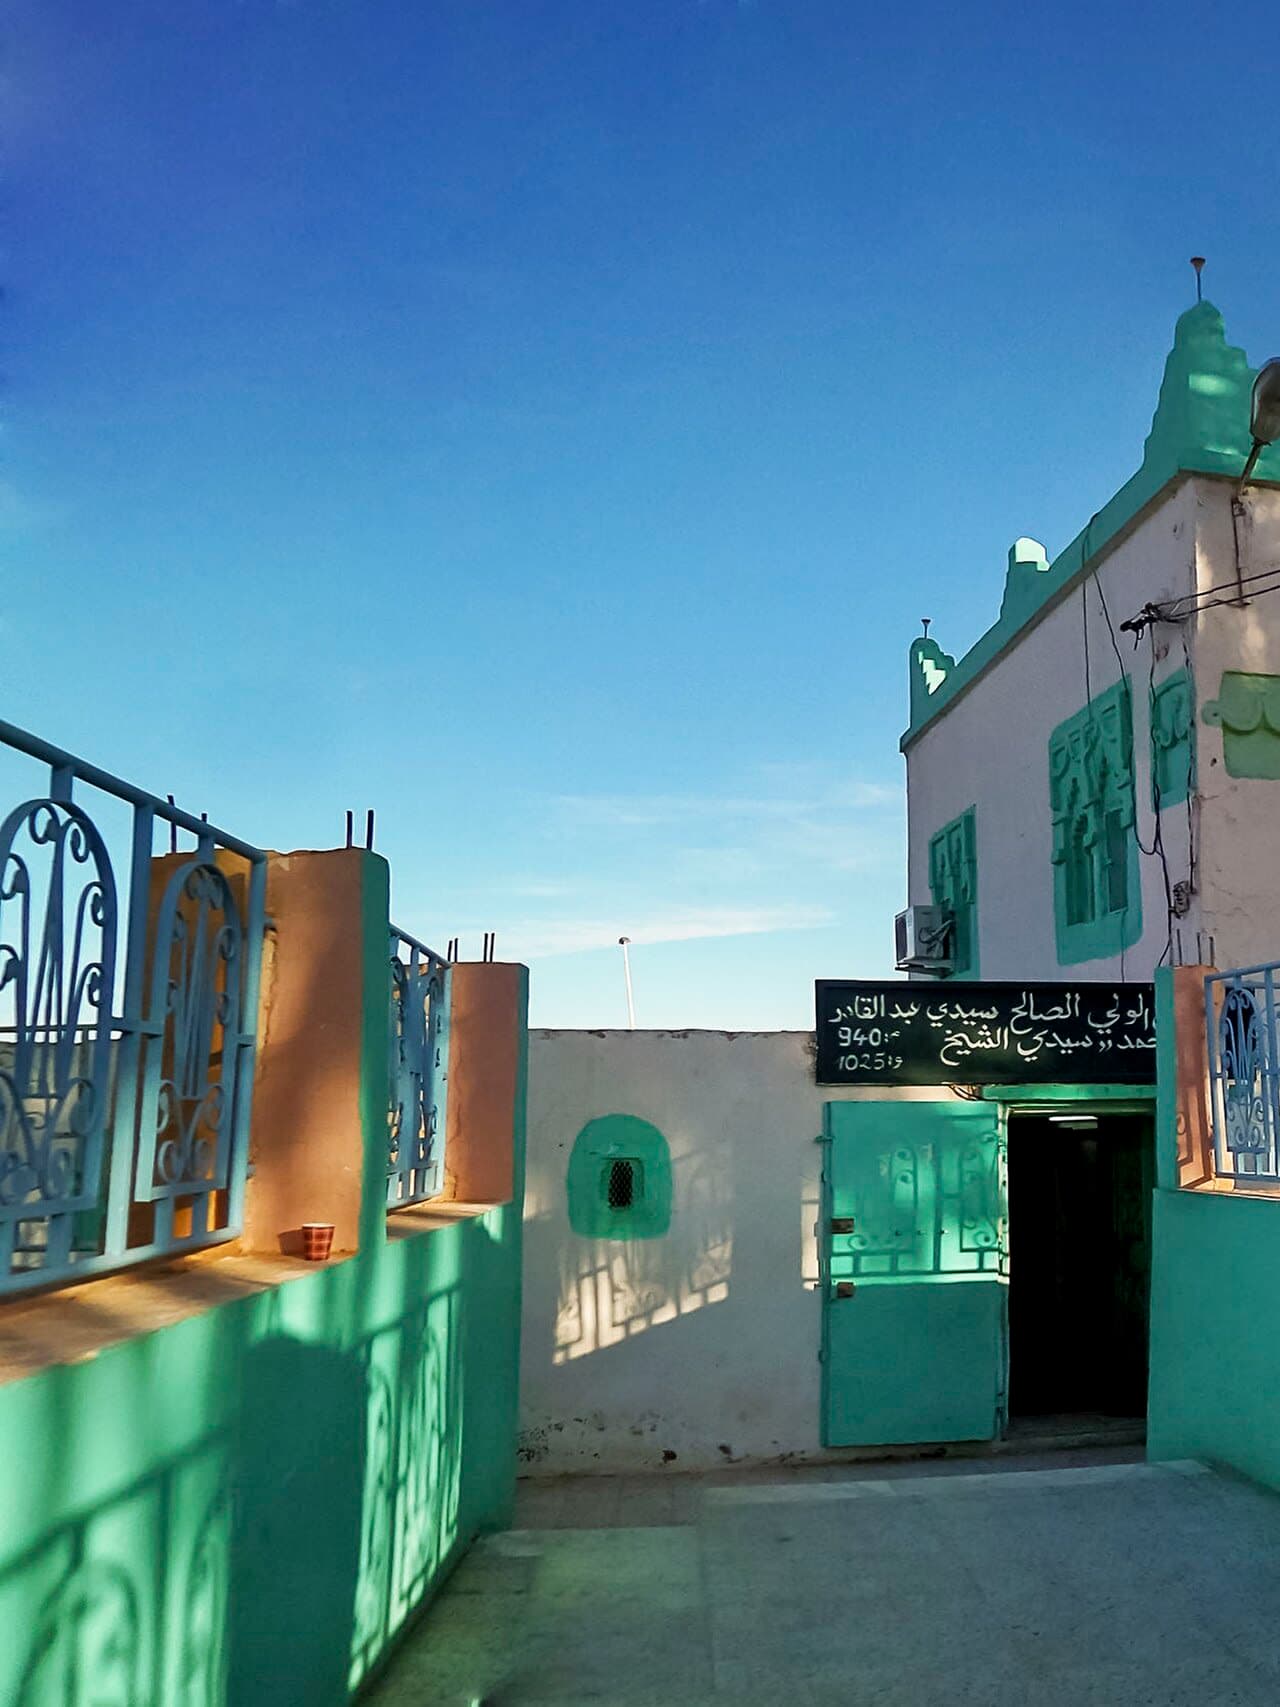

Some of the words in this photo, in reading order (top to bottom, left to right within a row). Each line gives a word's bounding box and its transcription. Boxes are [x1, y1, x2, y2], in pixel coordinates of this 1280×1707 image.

[888, 1001, 921, 1025] عبد
[926, 1002, 1000, 1027] سيدي
[1010, 990, 1081, 1035] الصالح
[1087, 992, 1150, 1035] الولي
[940, 1024, 1009, 1067] الشيخ
